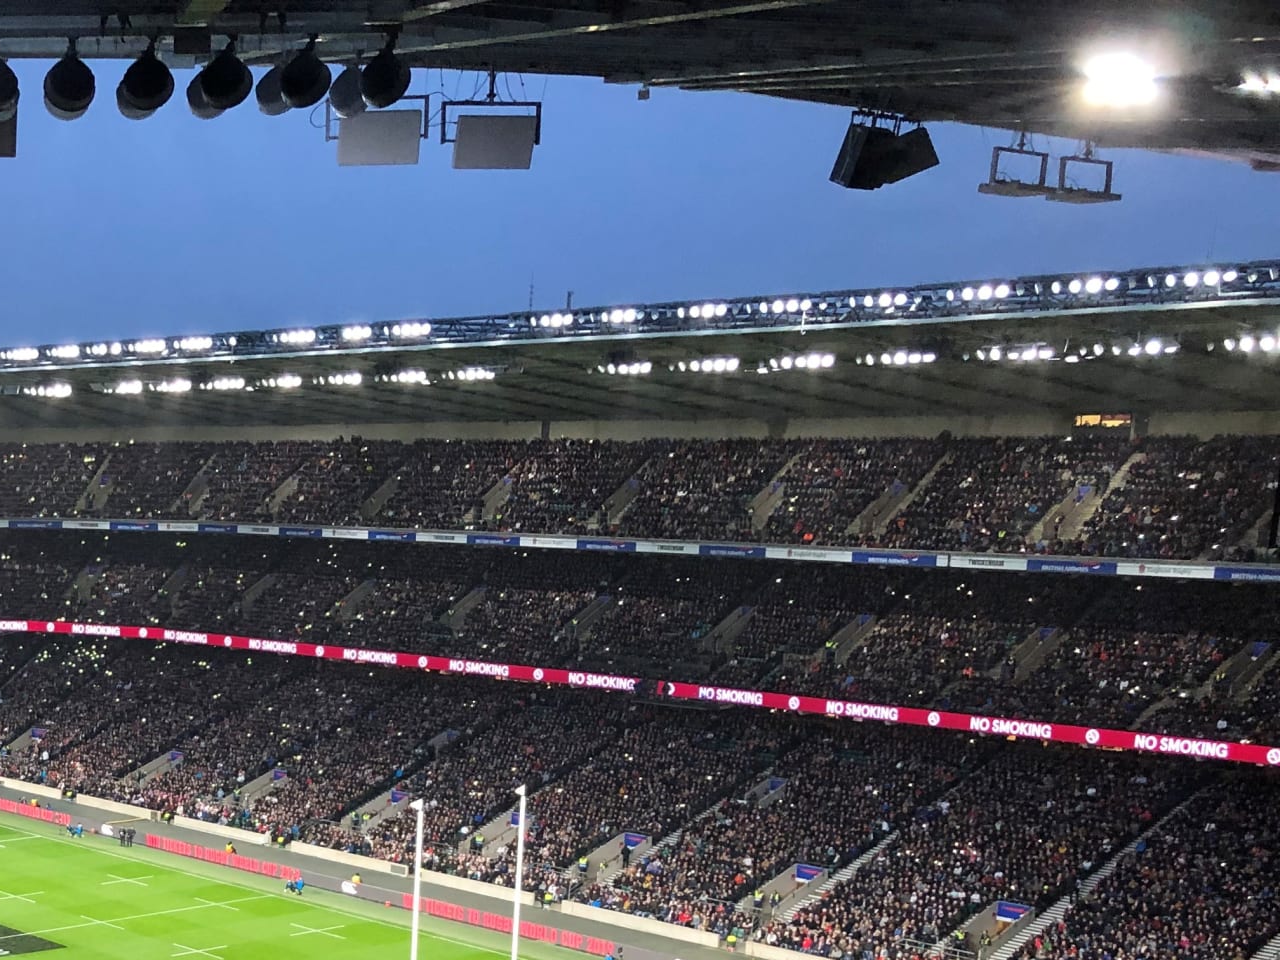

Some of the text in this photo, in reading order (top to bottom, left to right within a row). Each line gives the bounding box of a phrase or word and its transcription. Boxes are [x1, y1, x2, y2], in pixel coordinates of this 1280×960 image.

[72, 623, 83, 633] NO
[164, 630, 174, 640] NO
[249, 639, 260, 649] NO
[343, 649, 356, 660] NO
[449, 660, 508, 676] NO SMOKING
[569, 673, 635, 690] NO SMOKING
[699, 687, 763, 705] NO SMOKING
[826, 701, 898, 721] NO SMOKING
[970, 717, 1051, 739] NO SMOKING
[1134, 735, 1228, 758] NO SMOKING
